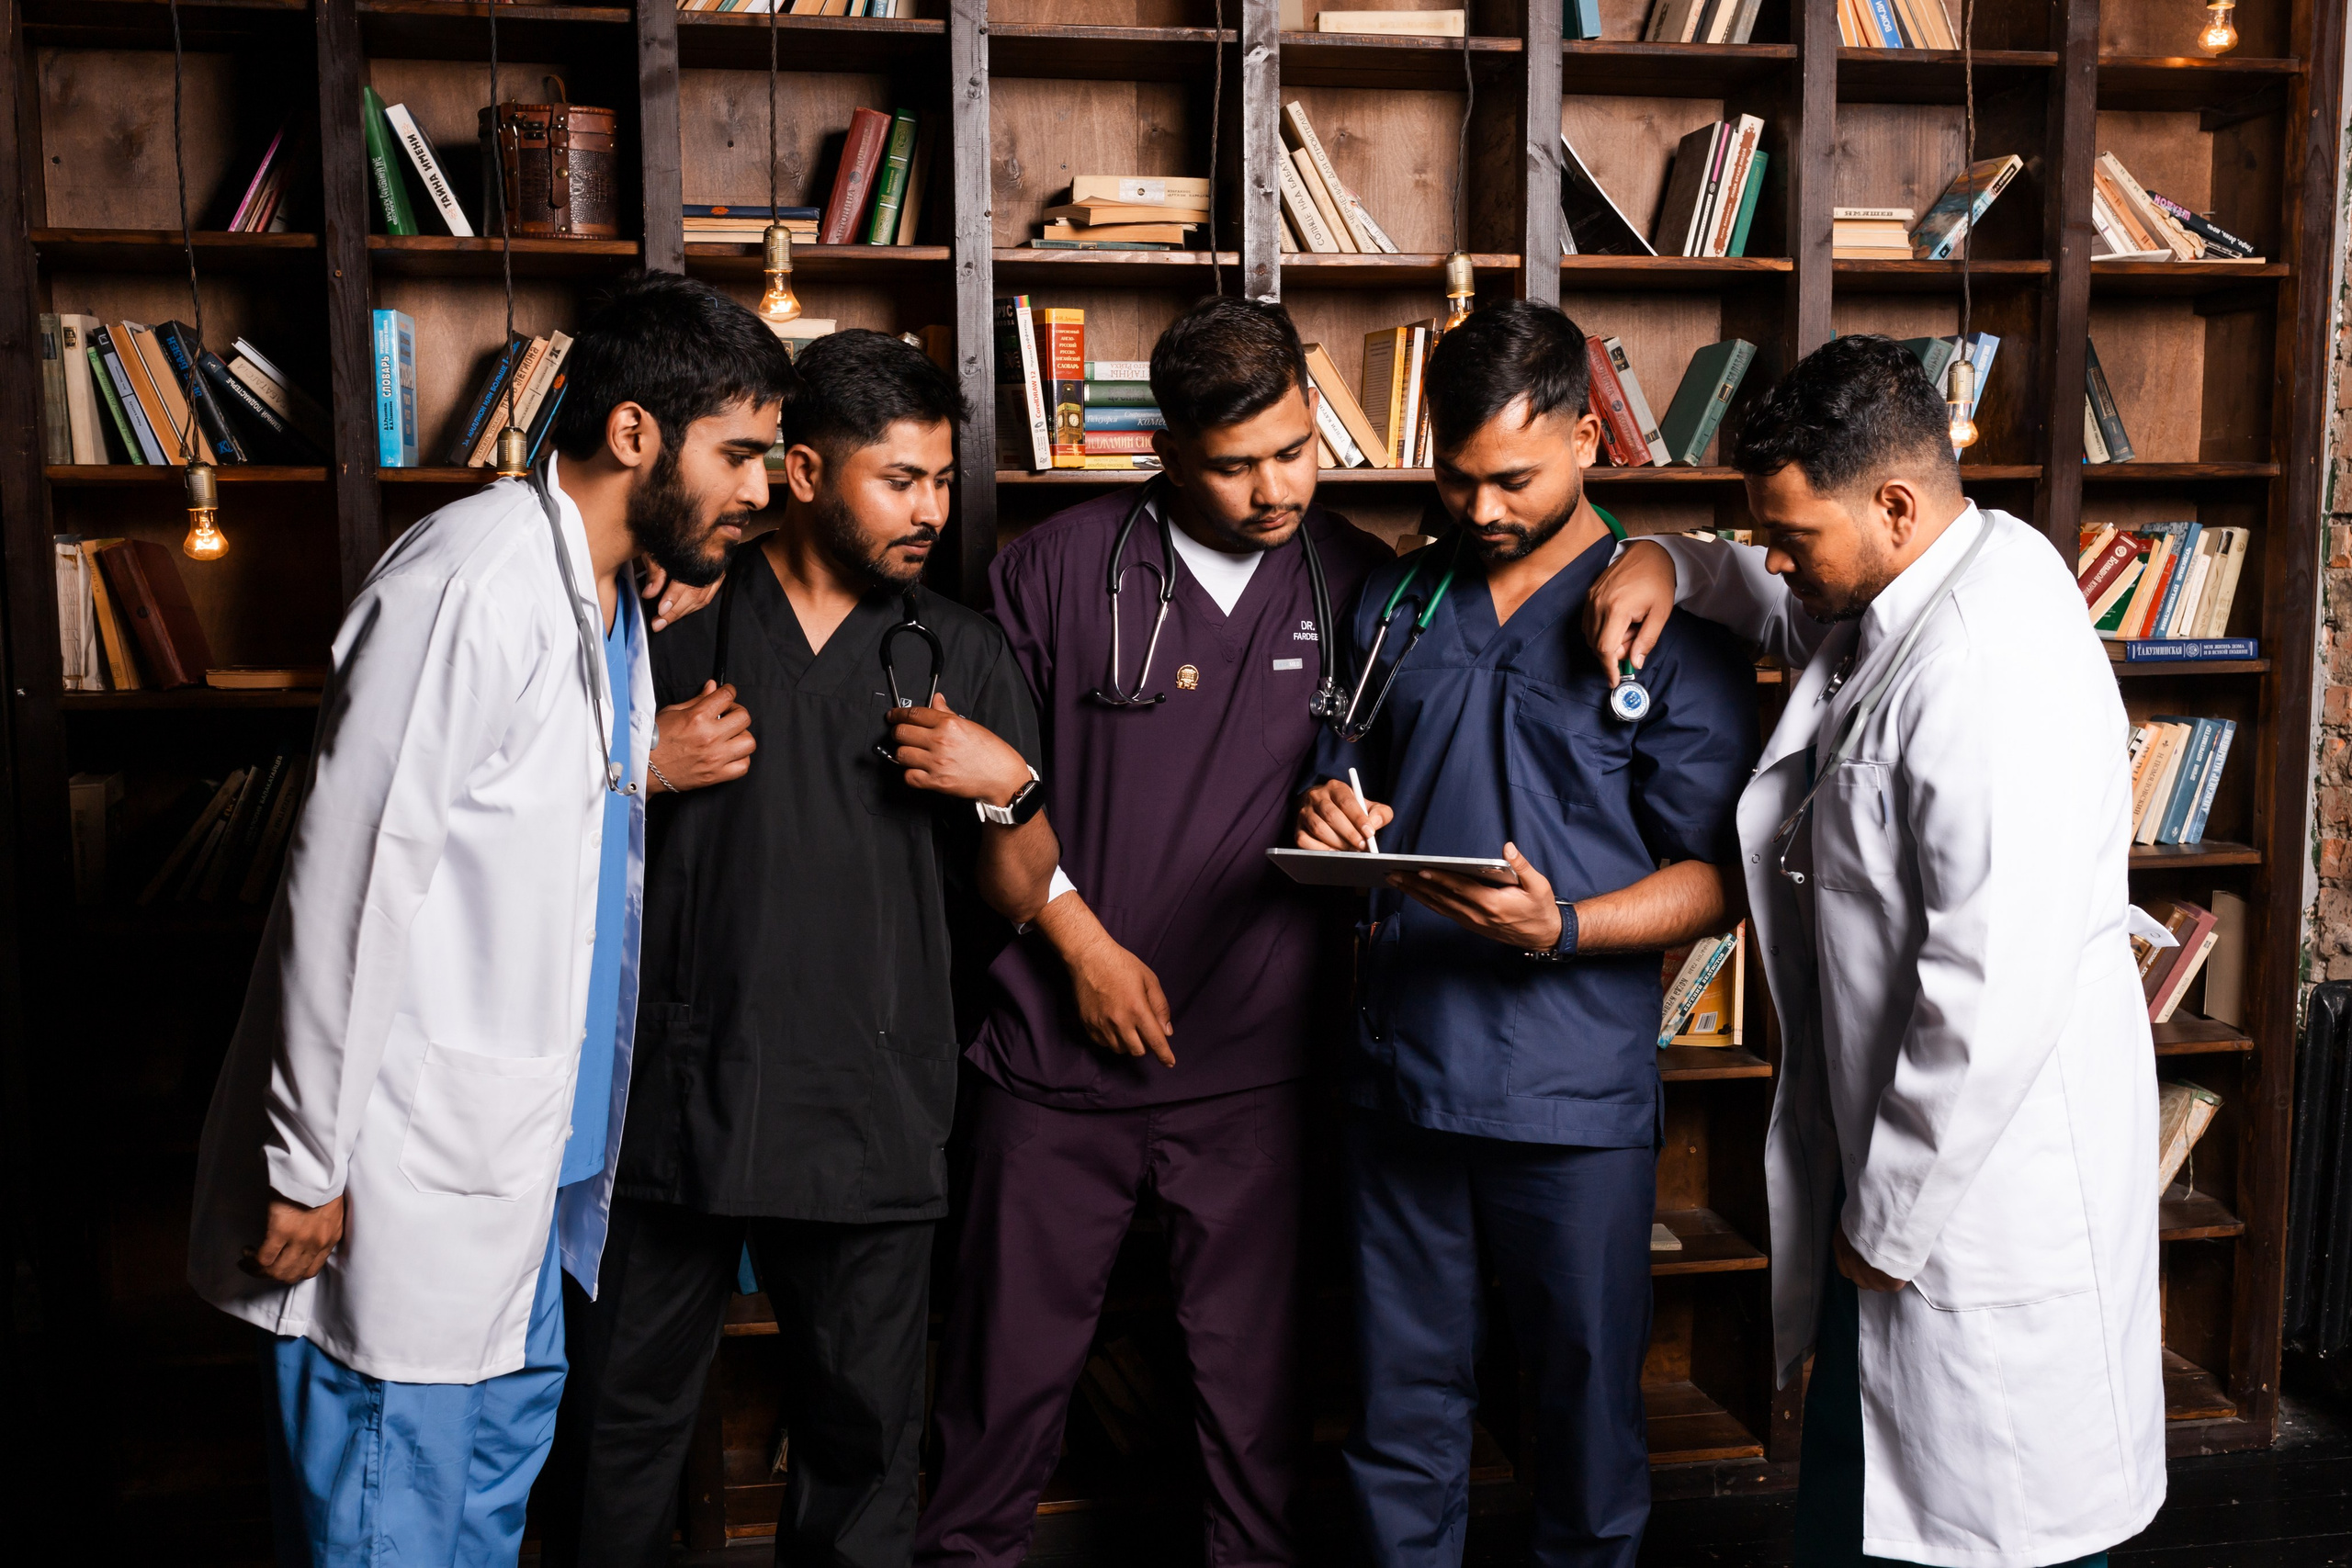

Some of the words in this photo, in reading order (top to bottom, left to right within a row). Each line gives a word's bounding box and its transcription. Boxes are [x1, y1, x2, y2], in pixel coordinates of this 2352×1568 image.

[1875, 0, 1893, 33] ВОЖДИ
[407, 134, 432, 172] ИМЕНИ
[1295, 109, 1326, 162] СТРОИТЕЛЕЙ
[1321, 164, 1336, 179] ДЛЯ
[429, 174, 452, 209] ТАЙНА
[1295, 190, 1308, 210] НАД
[1331, 181, 1355, 224] ЧЕРЧЕНИЕ
[836, 188, 855, 241] АНТОНИНА
[1304, 212, 1325, 246] СОЛНЦЕ
[2207, 223, 2222, 235] ночь
[166, 336, 189, 370] БАЗЕН
[1726, 348, 1748, 382] БАЛЗАК
[380, 355, 392, 398] СЛОВАРЬ
[1031, 370, 1036, 380] 12
[1110, 370, 1146, 378] ТАЙНЫ
[225, 377, 263, 412] ПОДМАСТЕРЬЕ
[462, 439, 470, 447] ЗА
[467, 406, 487, 438] МИЛЛИОН
[483, 390, 494, 407] ИЛИ
[491, 364, 509, 393] БОЛЬШЕ
[1031, 380, 1042, 419] CorelDRAW
[260, 411, 284, 433] ТЕМНЫЙ
[2160, 584, 2179, 631] ПУТЕШЕСТВИЯ
[1293, 632, 1318, 641] FARDEE
[1301, 620, 1316, 631] DR.
[2133, 760, 2162, 816] ПОМЯЛОВСКИЙ
[2202, 773, 2220, 811] АЛЕКСАНДР
[1683, 984, 1703, 1012] ЕВГЕНИЙ
[1702, 953, 1724, 984] ВЕЛТИСТОВ
